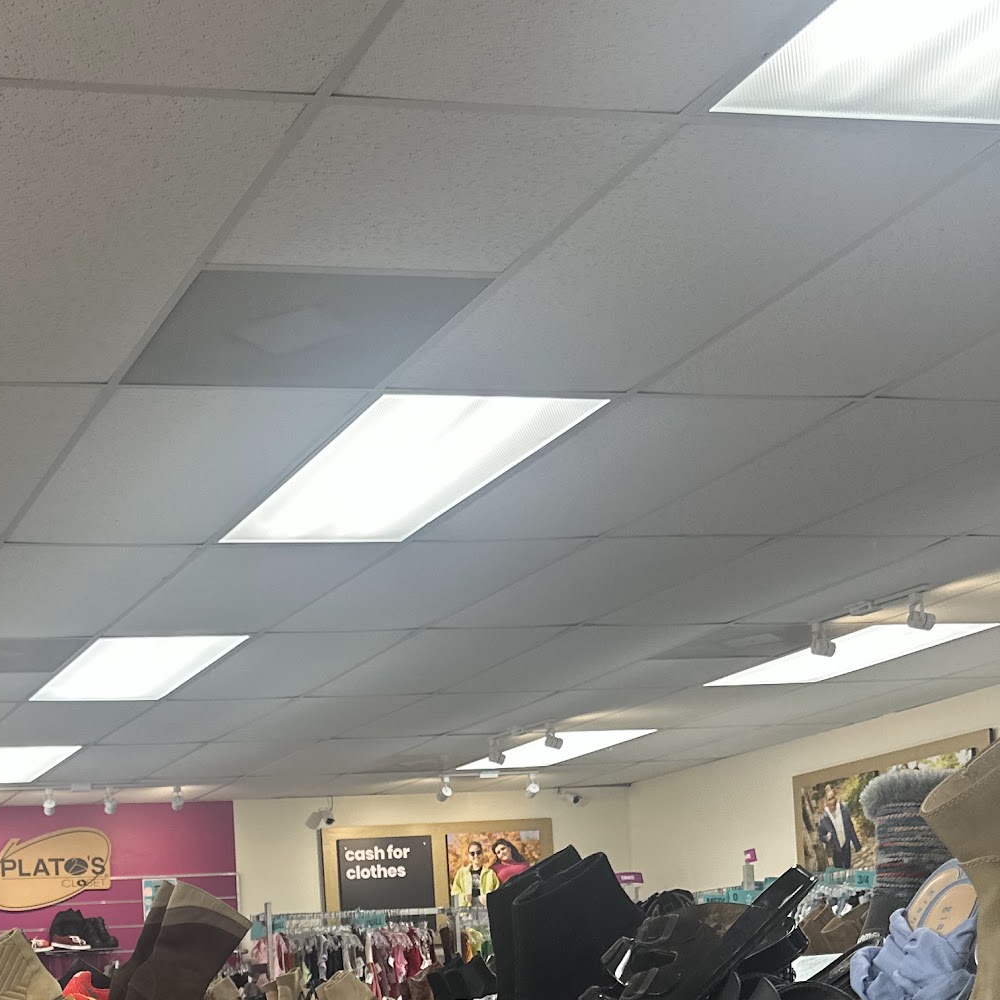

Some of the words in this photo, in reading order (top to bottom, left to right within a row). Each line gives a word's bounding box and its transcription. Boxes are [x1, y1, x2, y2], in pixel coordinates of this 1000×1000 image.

[345, 845, 385, 861] cash
[387, 844, 410, 859] for
[346, 864, 406, 880] clothes
